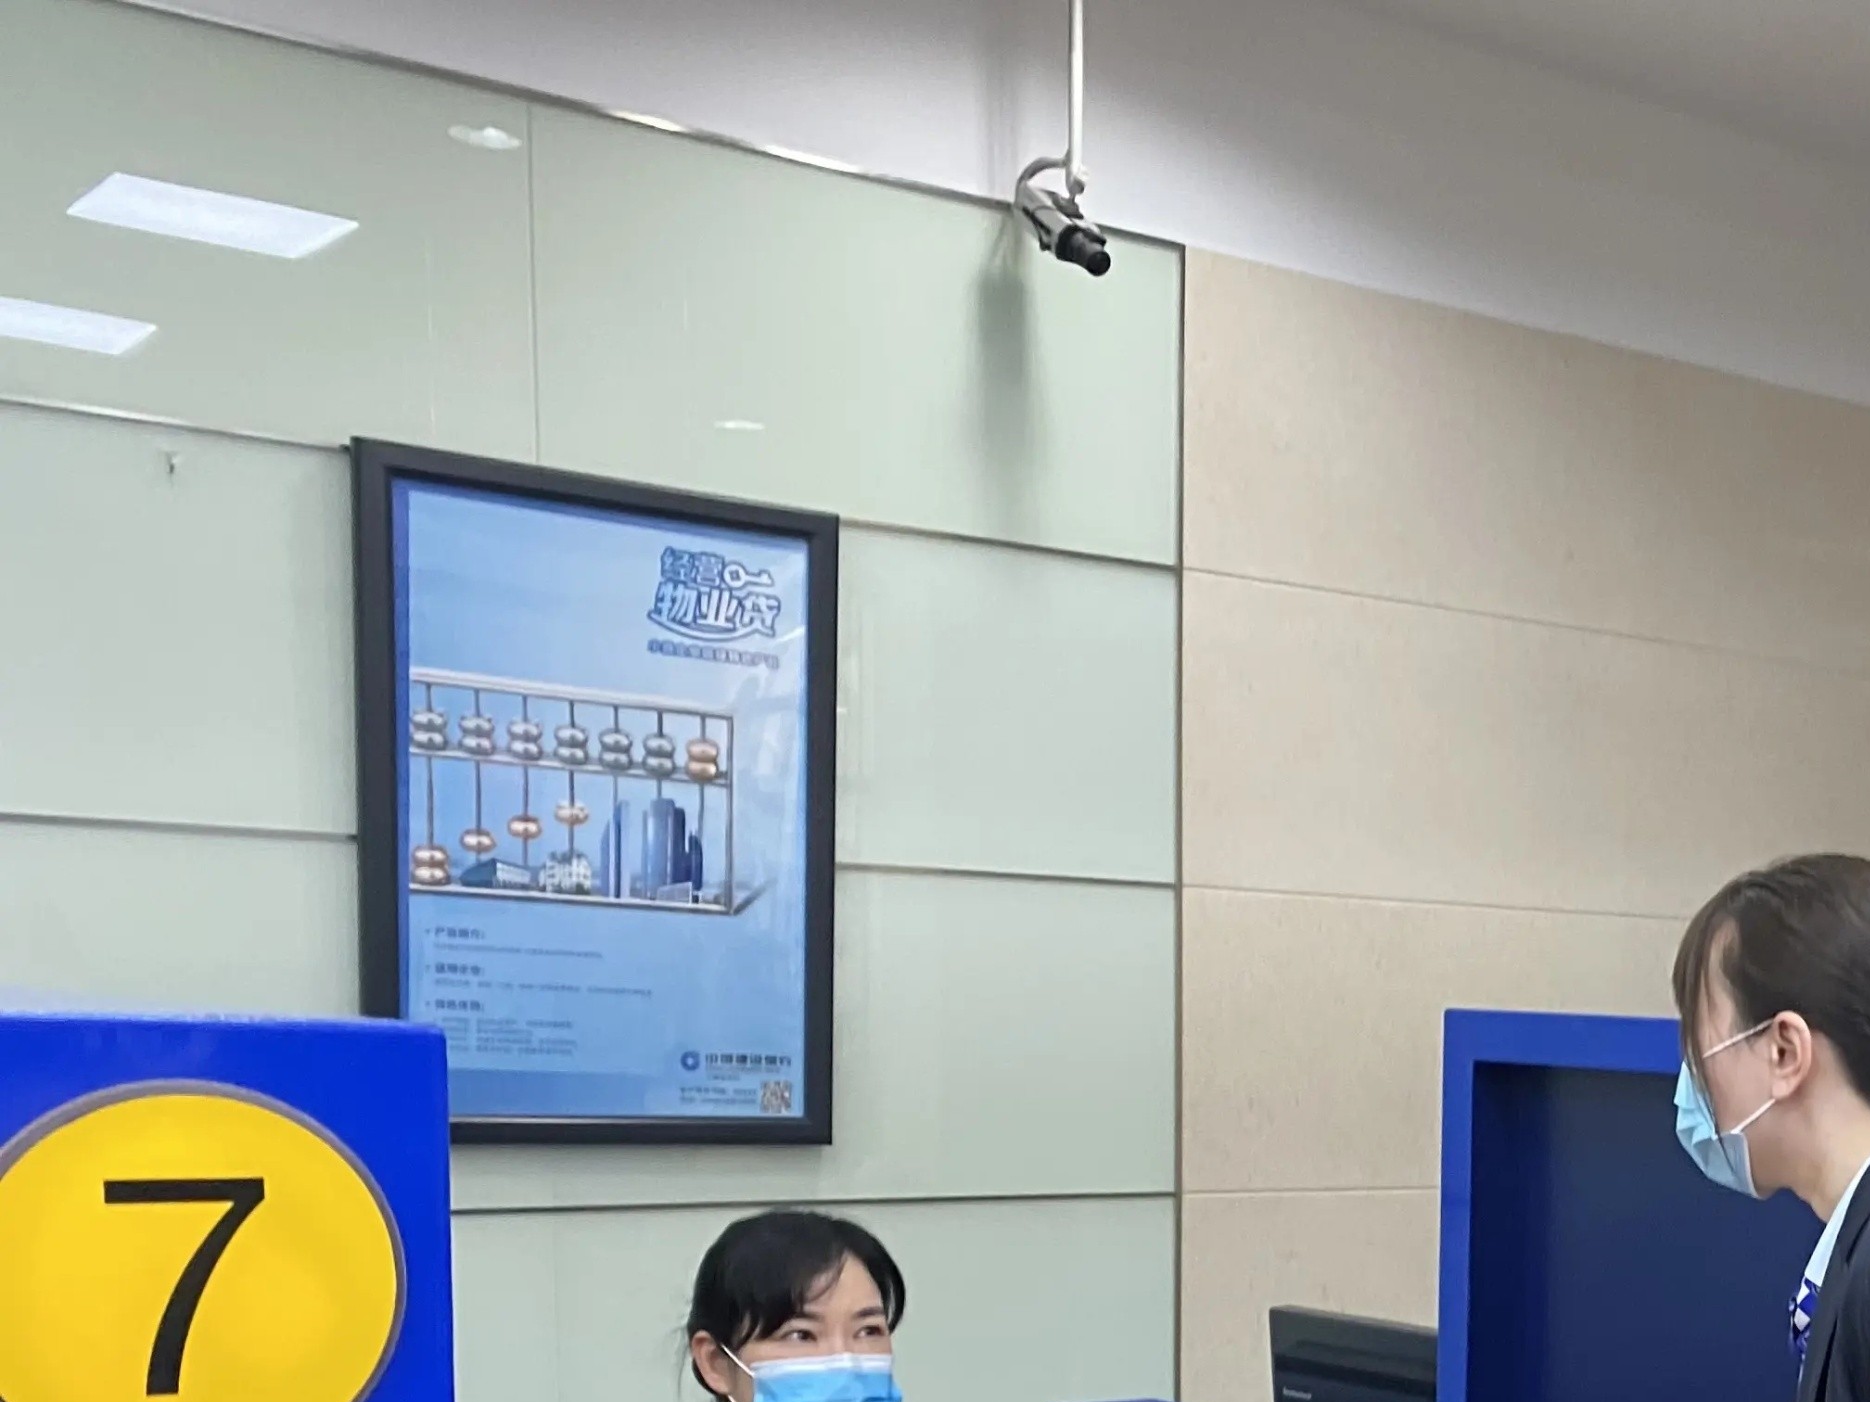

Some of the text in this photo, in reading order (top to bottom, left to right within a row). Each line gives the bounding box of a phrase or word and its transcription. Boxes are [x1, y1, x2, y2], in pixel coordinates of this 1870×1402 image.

[652, 580, 781, 638] 物业贷
[103, 1177, 265, 1397] 7
